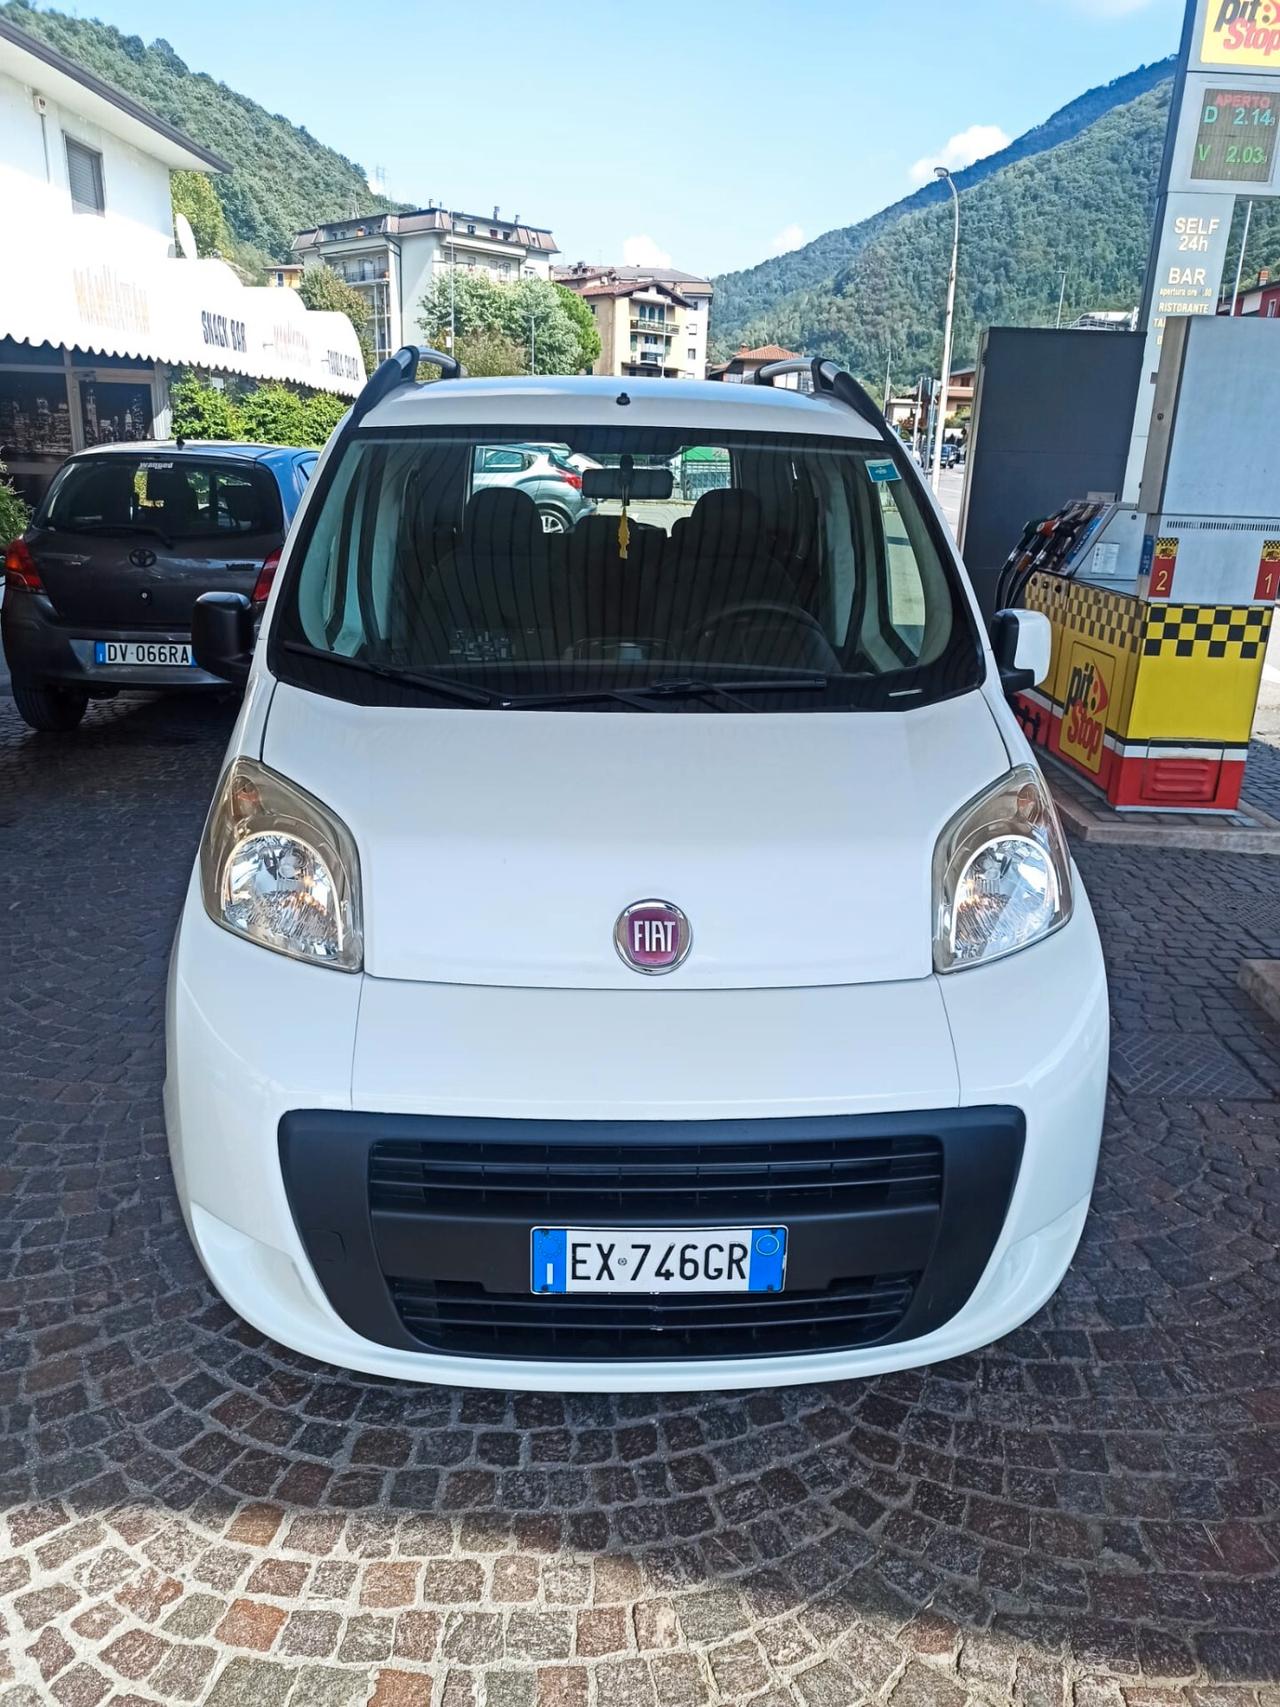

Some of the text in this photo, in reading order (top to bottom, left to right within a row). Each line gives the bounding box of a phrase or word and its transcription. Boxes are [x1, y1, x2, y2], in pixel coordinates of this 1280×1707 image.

[1223, 17, 1280, 56] Stop
[1216, 93, 1271, 109] APERTO
[1203, 105, 1218, 123] D
[1198, 143, 1211, 161] V
[1174, 217, 1219, 235] SELF
[1178, 236, 1208, 252] 24h
[1168, 267, 1205, 285] BAR
[1158, 302, 1209, 314] RISTORANTE
[230, 319, 248, 353] BAR
[1156, 570, 1168, 591] 2
[1264, 573, 1273, 594] 1
[107, 644, 128, 662] DV
[137, 645, 190, 664] 066RA
[1064, 662, 1095, 716] pit
[1067, 698, 1103, 761] Stop
[633, 920, 676, 952] FIAT
[571, 1243, 615, 1280] EX
[630, 1242, 748, 1281] 746GR
